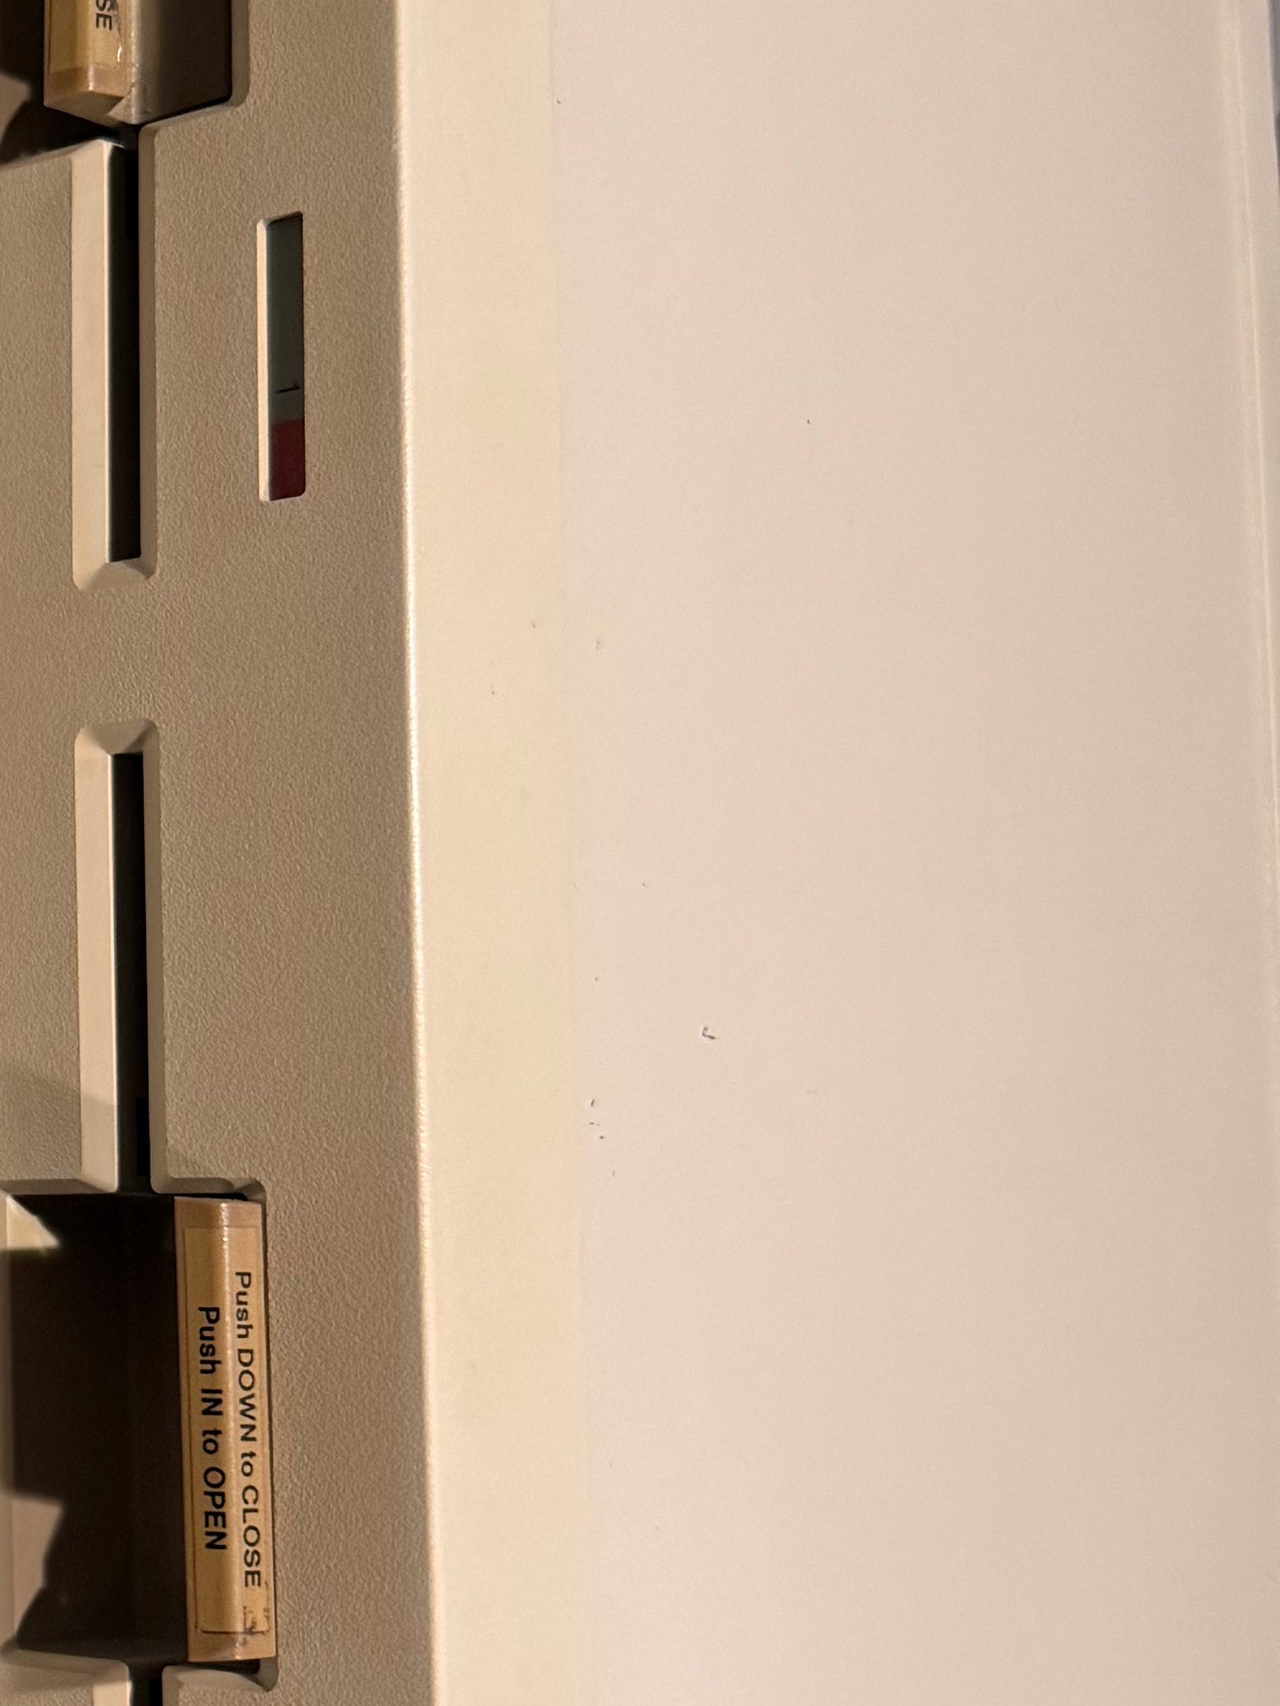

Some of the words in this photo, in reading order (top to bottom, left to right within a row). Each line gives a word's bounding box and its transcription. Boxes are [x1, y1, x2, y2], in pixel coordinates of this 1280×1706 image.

[235, 1271, 253, 1338] Push
[198, 1307, 221, 1374] Push
[201, 1389, 223, 1415] IN
[237, 1348, 256, 1441] DOWN
[202, 1429, 223, 1453] to
[240, 1452, 256, 1476] to
[203, 1467, 227, 1550] OPEN
[242, 1485, 262, 1587] CLOSE
